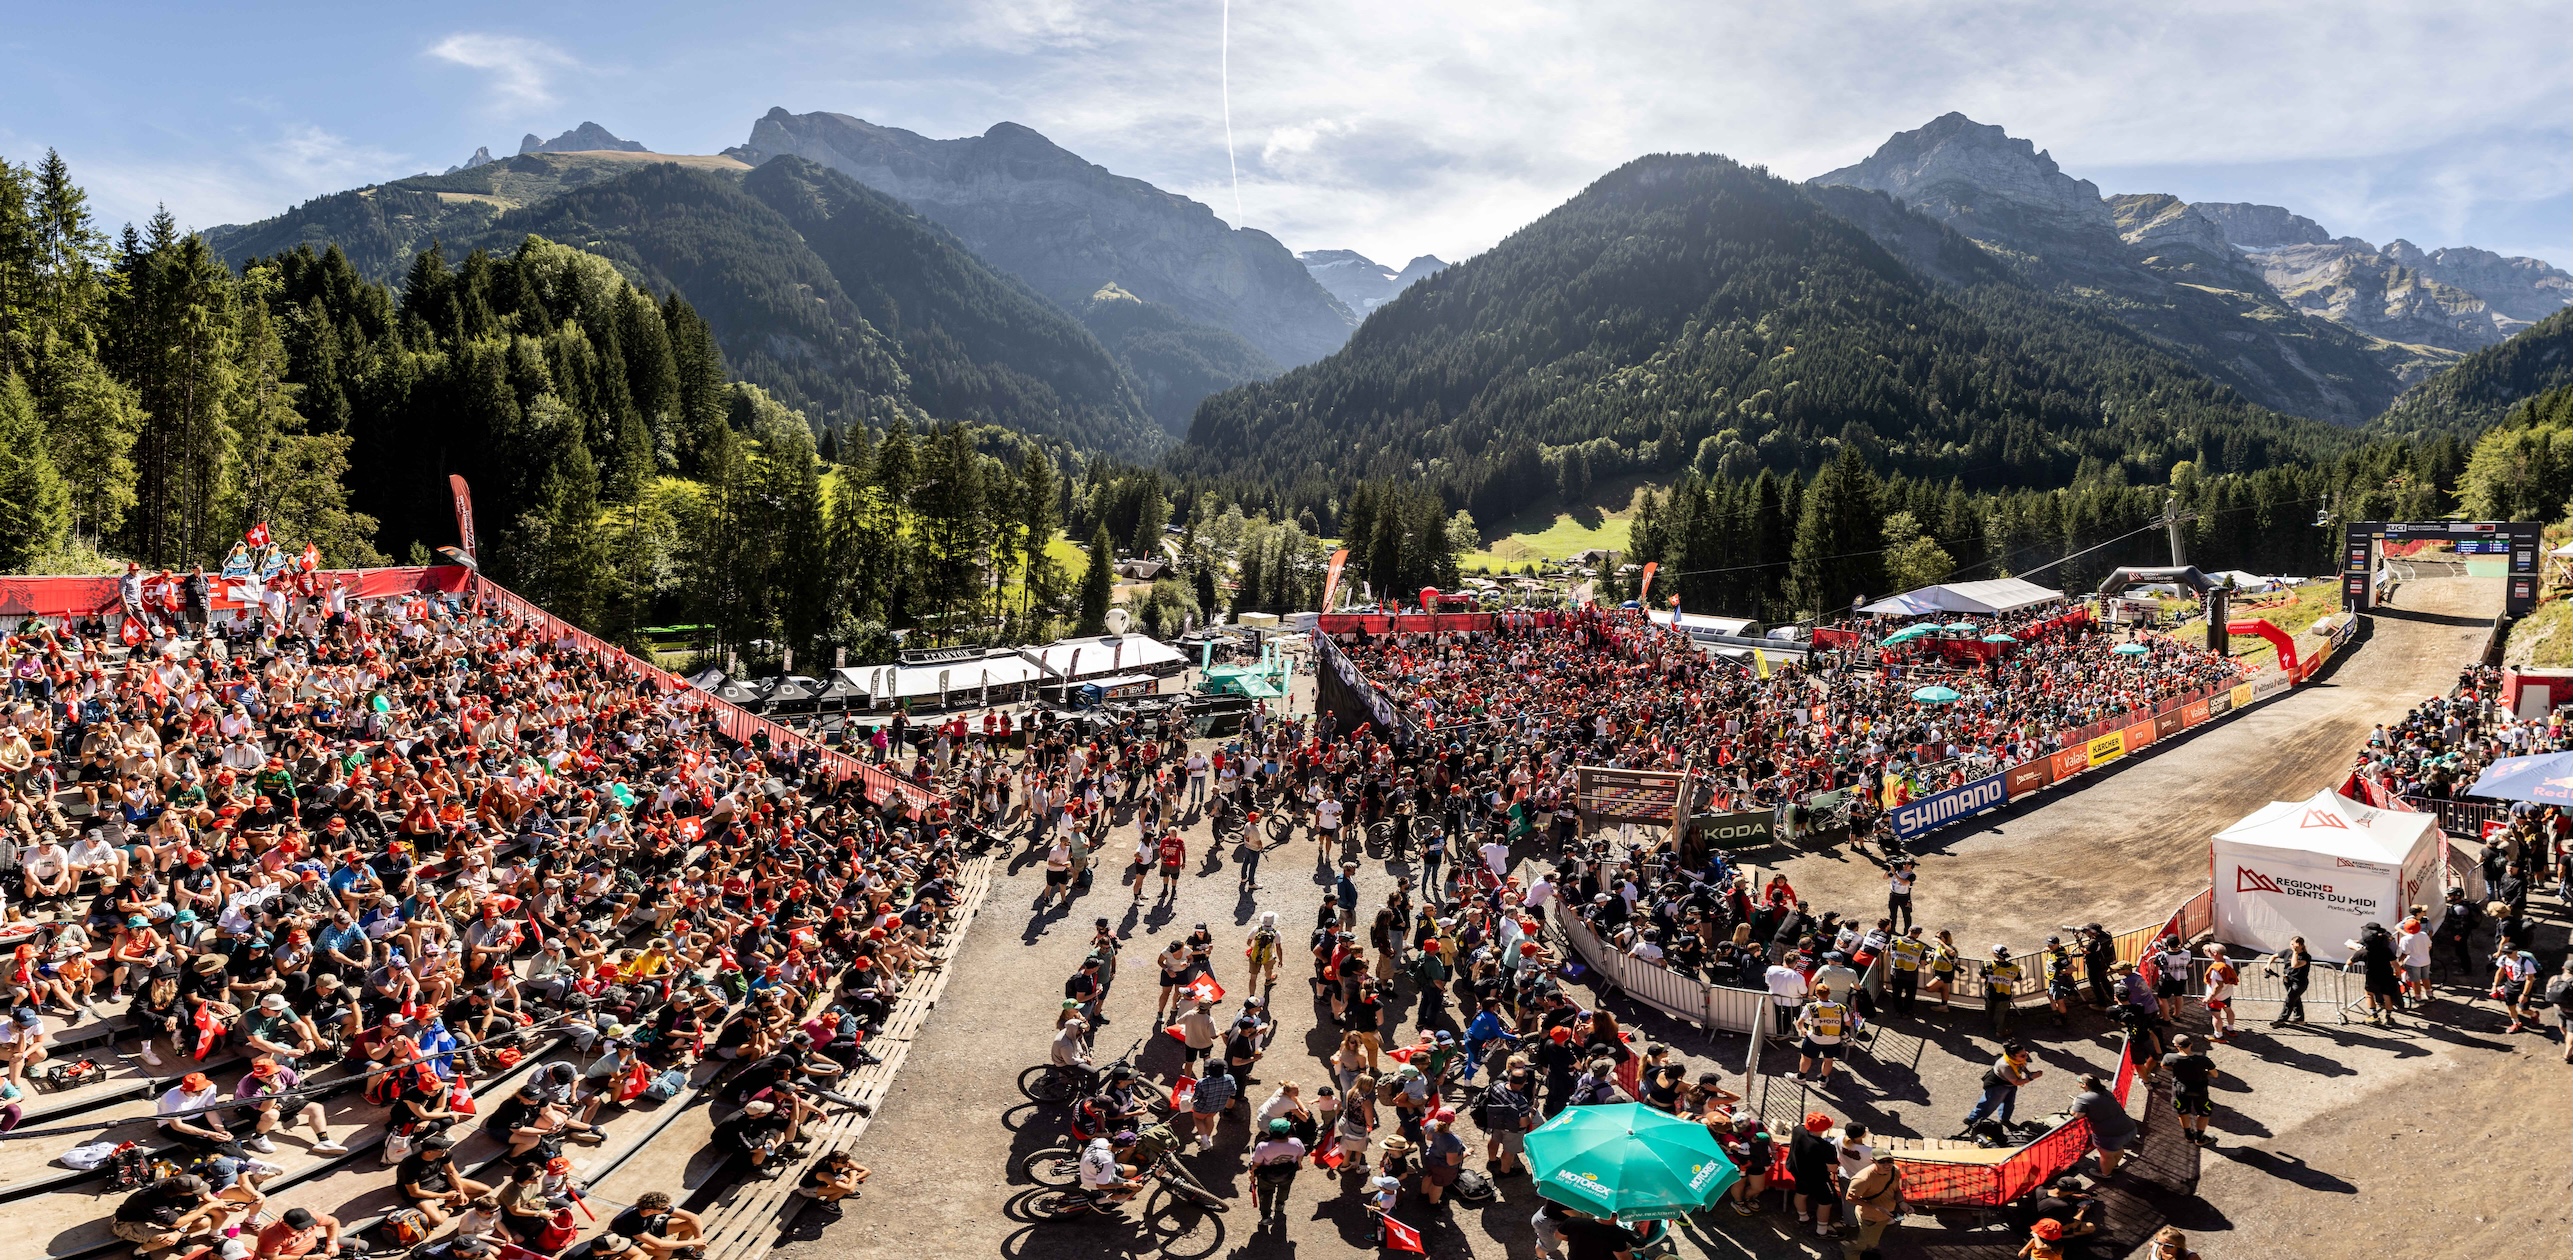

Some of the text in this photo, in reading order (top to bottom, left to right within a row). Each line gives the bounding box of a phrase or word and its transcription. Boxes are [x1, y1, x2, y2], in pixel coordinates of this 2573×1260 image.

[2210, 693, 2230, 706] OCHSNER
[2190, 704, 2208, 719] Valais
[2210, 703, 2225, 714] SPORT
[2092, 738, 2120, 754] KÄRCHER
[2064, 750, 2087, 768] Valais
[2533, 786, 2568, 798] Red
[1899, 780, 2002, 834] SHIMANO
[2276, 877, 2322, 891] REGION
[2288, 888, 2376, 908] DENTS DU MIDI
[2327, 904, 2346, 912] Portes
[2354, 906, 2376, 916] Soleil
[1559, 1169, 1613, 1196] MOTOREX
[1689, 1160, 1719, 1190] MOTOREX
[1573, 1181, 1608, 1200] Switzerland
